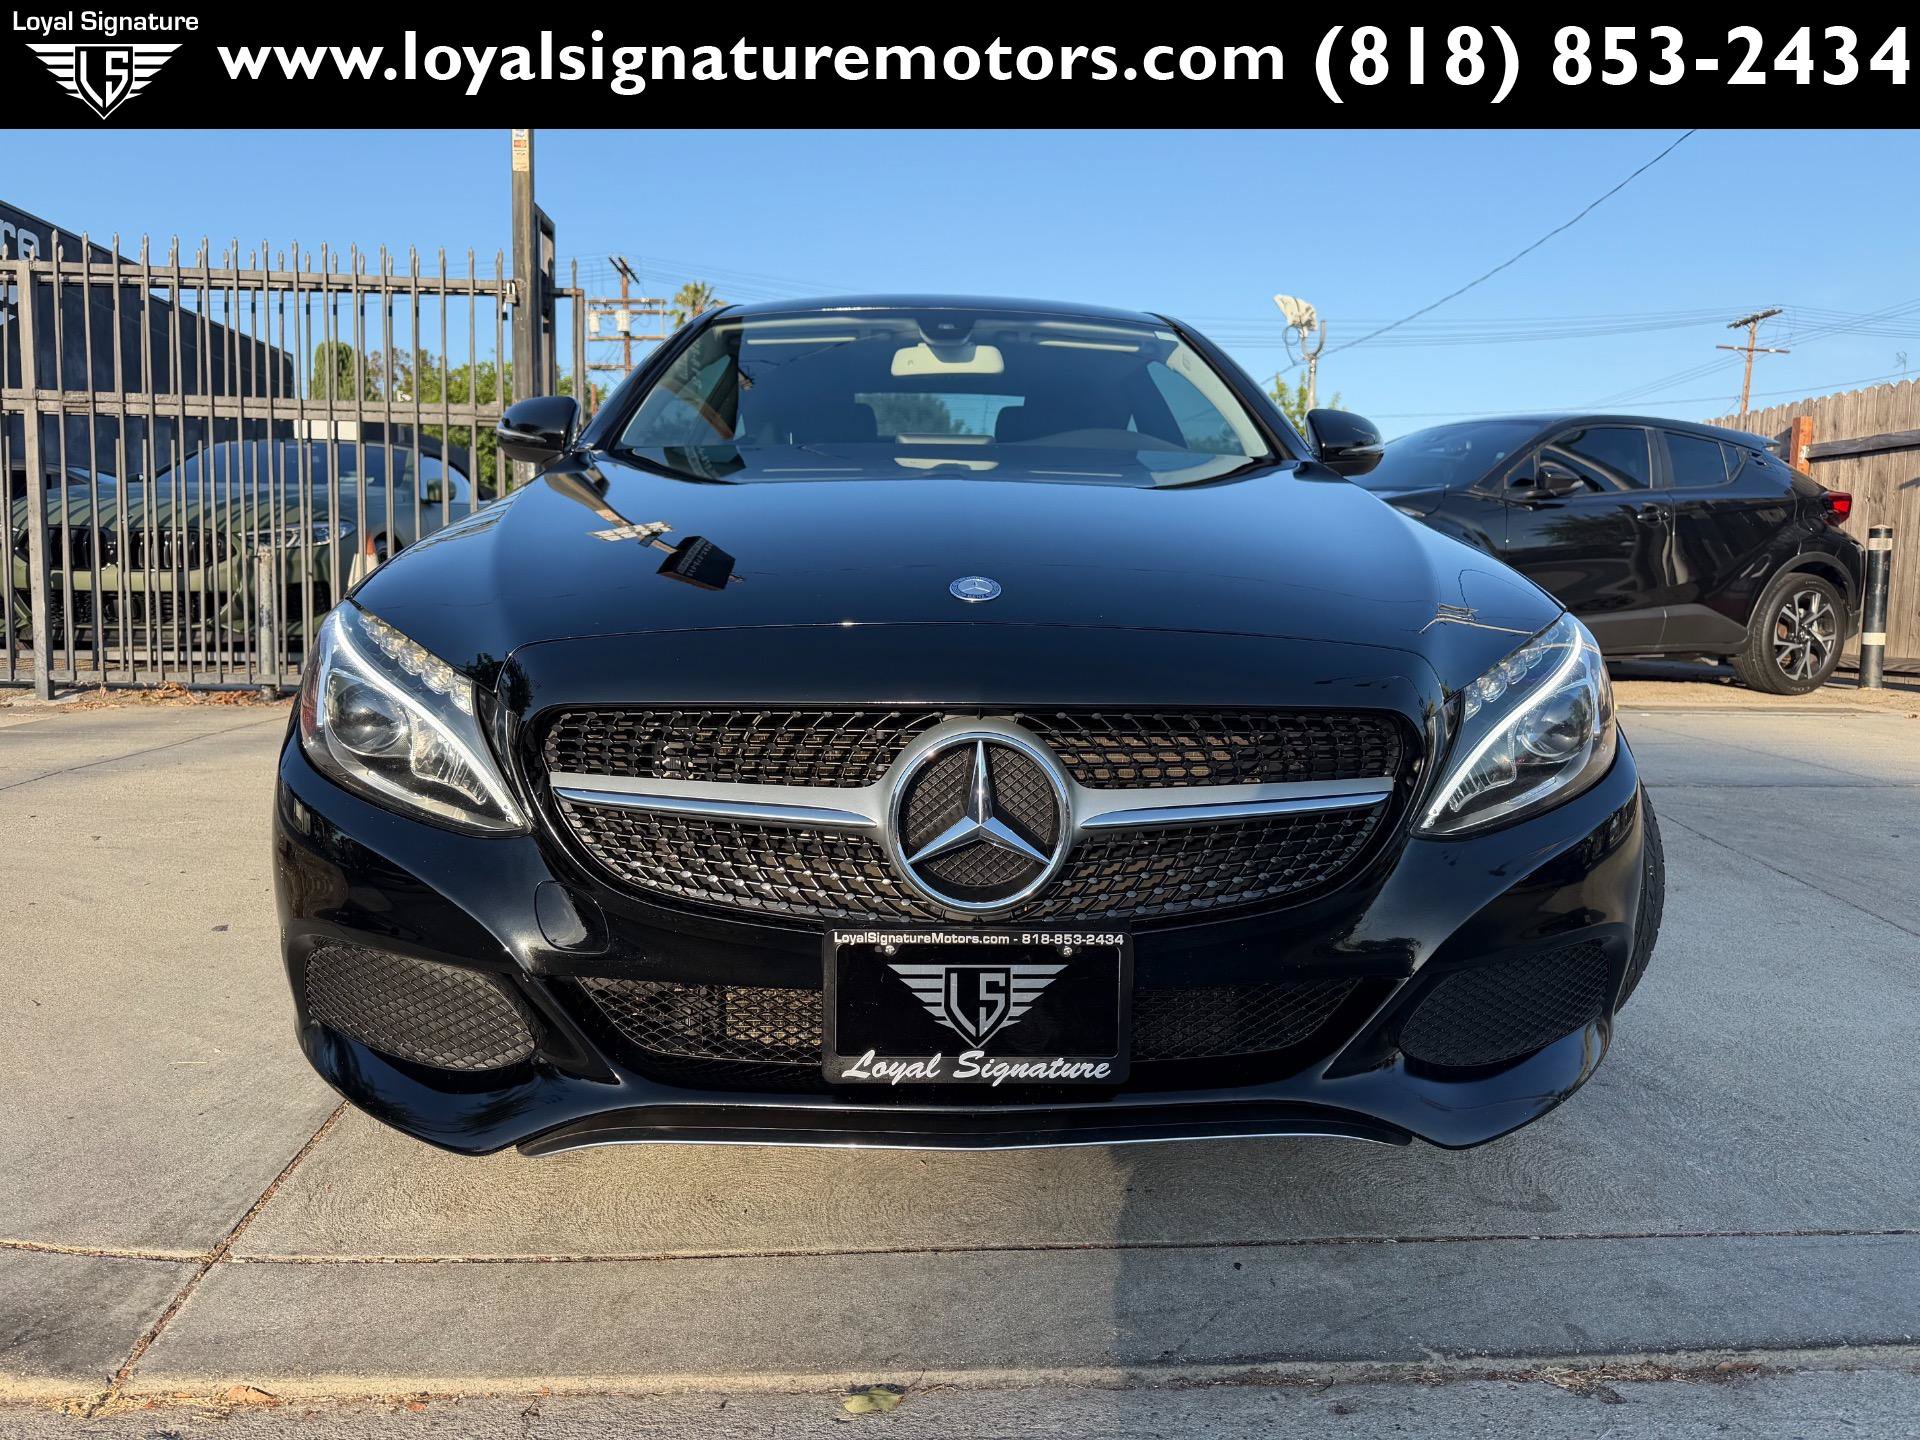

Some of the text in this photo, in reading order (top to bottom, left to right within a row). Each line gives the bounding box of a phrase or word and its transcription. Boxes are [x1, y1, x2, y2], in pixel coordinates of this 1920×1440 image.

[834, 931, 1010, 945] LoyalSignatureMotors.com
[1021, 933, 1124, 946] 818-853-2434
[841, 1049, 1111, 1087] Loyal Signature
